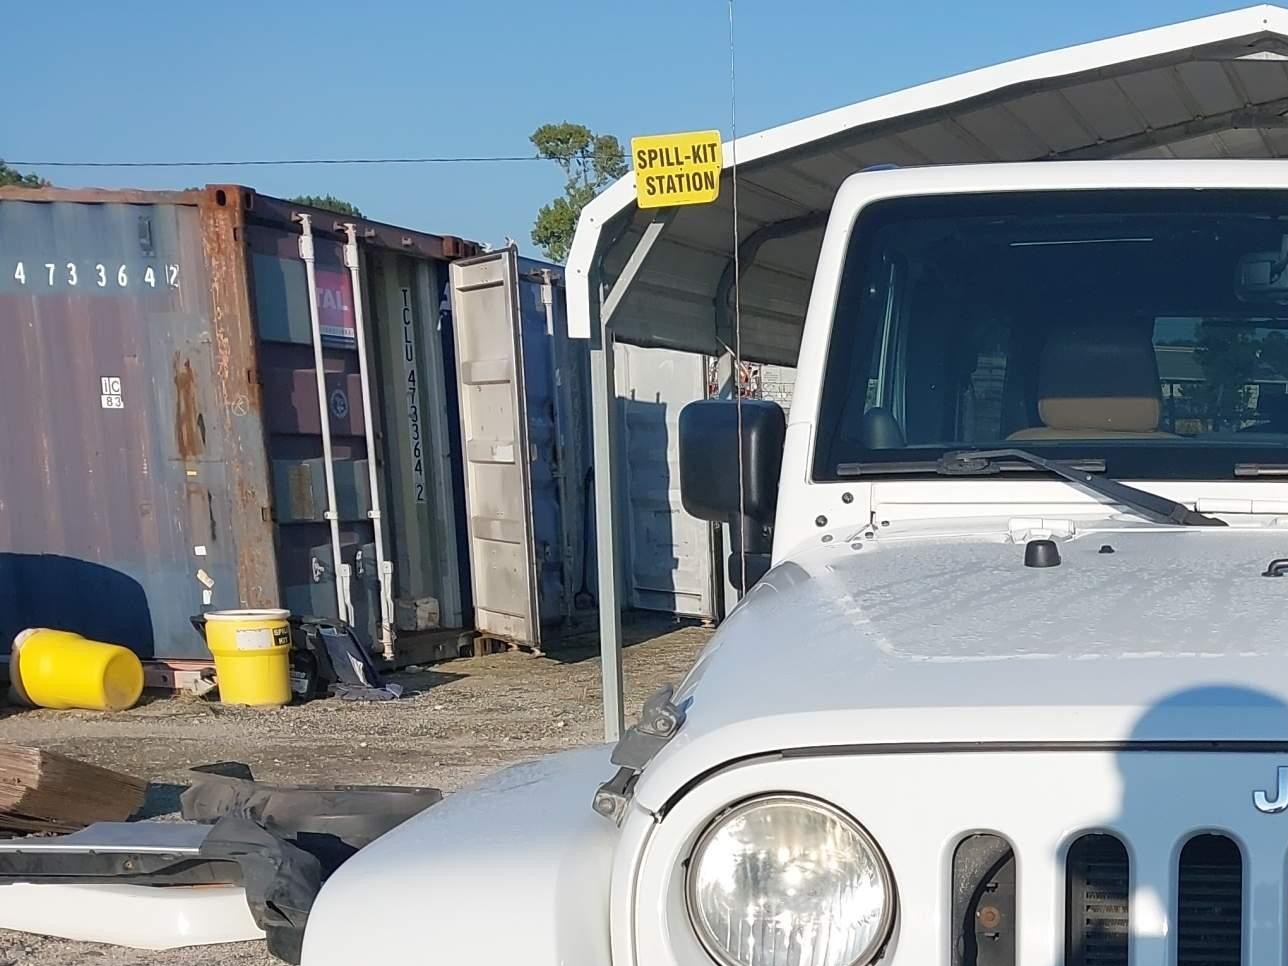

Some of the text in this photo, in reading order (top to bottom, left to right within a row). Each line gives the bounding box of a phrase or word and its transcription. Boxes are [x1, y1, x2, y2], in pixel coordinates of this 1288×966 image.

[637, 143, 718, 169] SPILL-KIT
[646, 171, 715, 195] STATION
[402, 289, 414, 361] TCLU
[105, 396, 122, 408] 83
